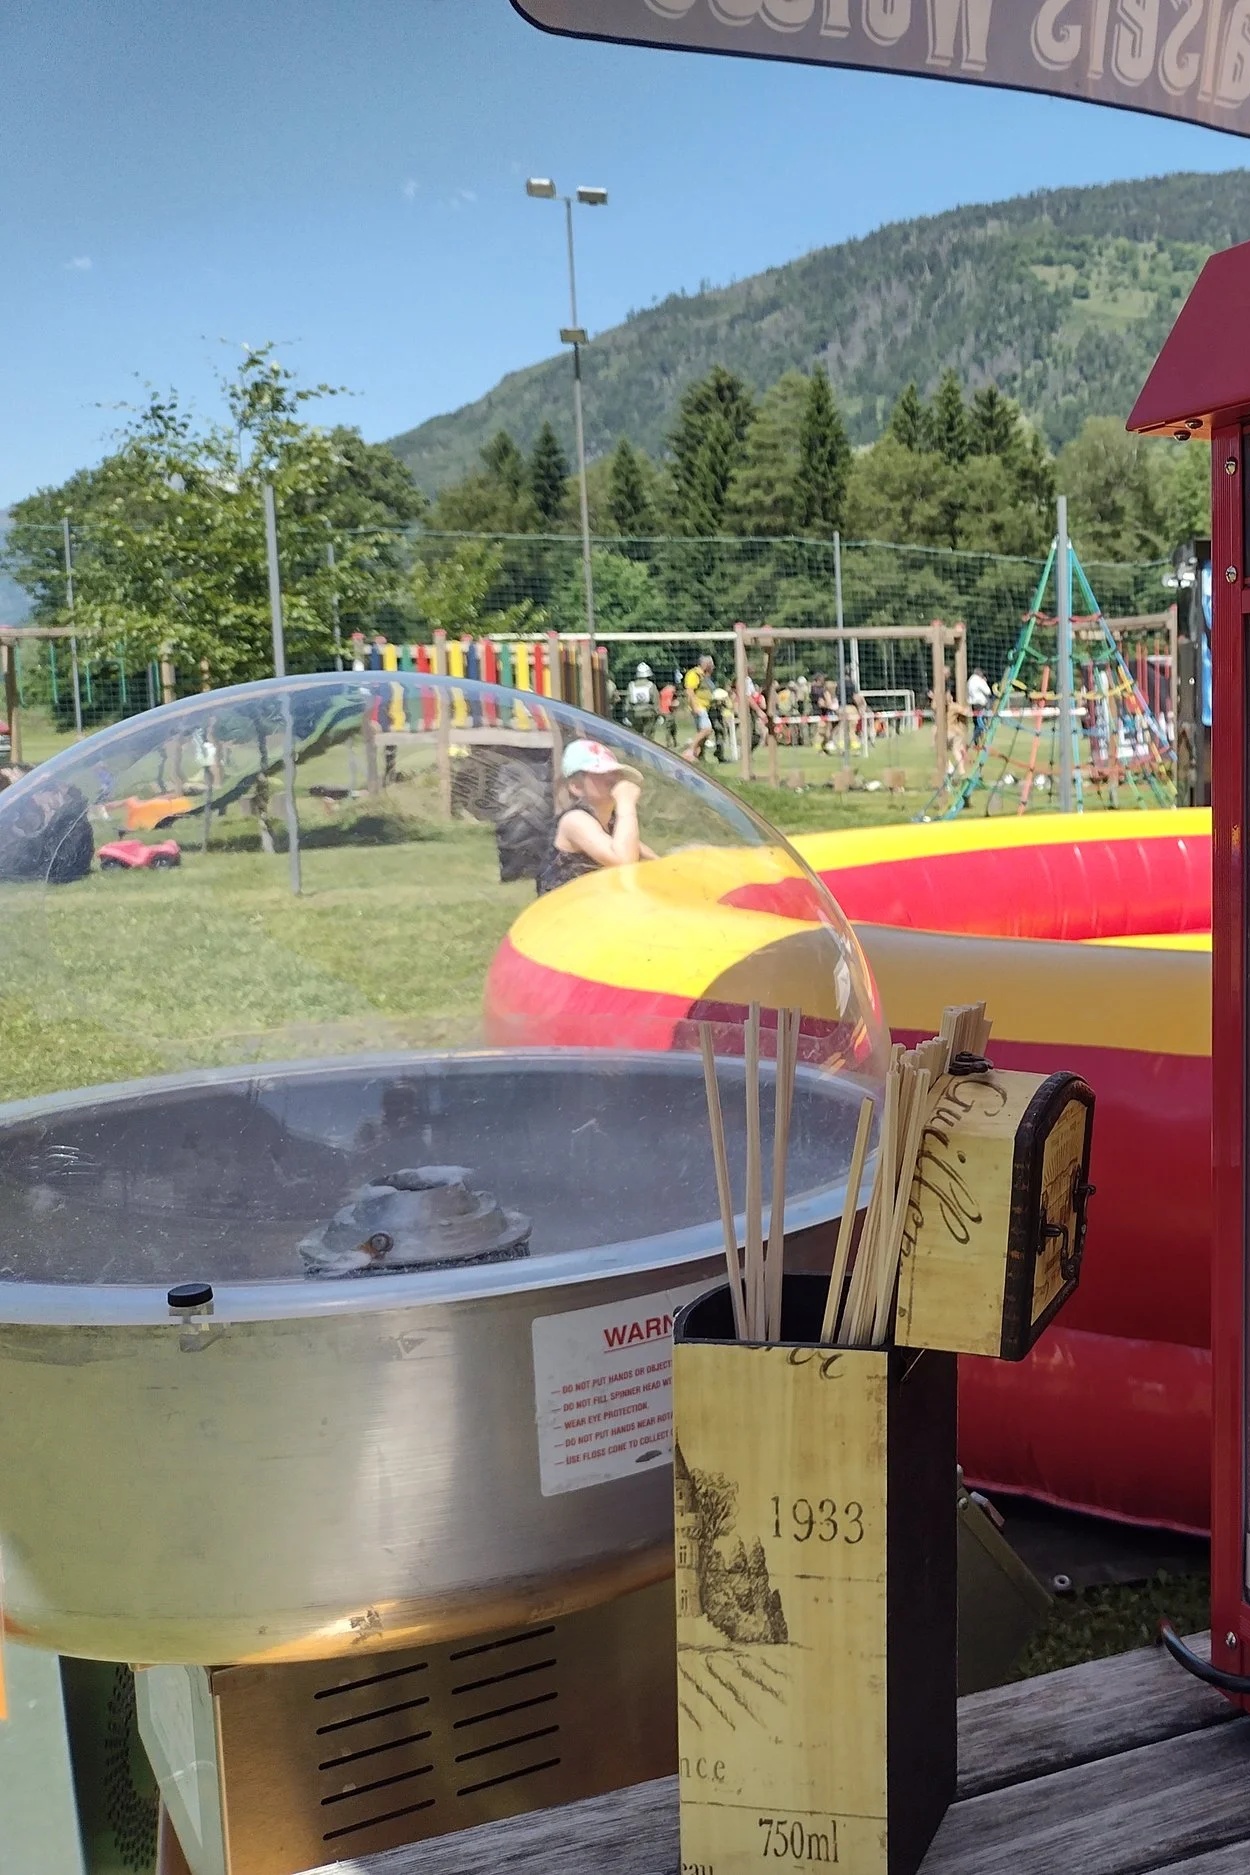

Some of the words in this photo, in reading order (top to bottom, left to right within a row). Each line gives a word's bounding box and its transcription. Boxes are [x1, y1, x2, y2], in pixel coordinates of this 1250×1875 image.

[575, 1380, 590, 1391] NOT
[592, 1376, 606, 1388] PUT
[608, 1370, 633, 1384] HANDS
[635, 1367, 645, 1376] OR
[576, 1398, 591, 1409] NOT
[593, 1395, 608, 1406] FILL
[610, 1386, 641, 1400] SPINNER
[642, 1380, 661, 1392] HEAD
[564, 1417, 587, 1429] WEAR
[588, 1413, 602, 1424] EYE
[578, 1433, 593, 1445] NOT
[595, 1430, 610, 1441] PUT
[611, 1422, 636, 1436] HANDS
[637, 1416, 656, 1429] NEAR
[566, 1454, 581, 1465] USE
[583, 1448, 606, 1461] FLOSS
[608, 1442, 627, 1454] CONE
[629, 1439, 638, 1449] TO
[640, 1429, 669, 1443] COLLECT
[771, 1496, 864, 1544] 1933
[758, 1817, 839, 1863] 750ml
